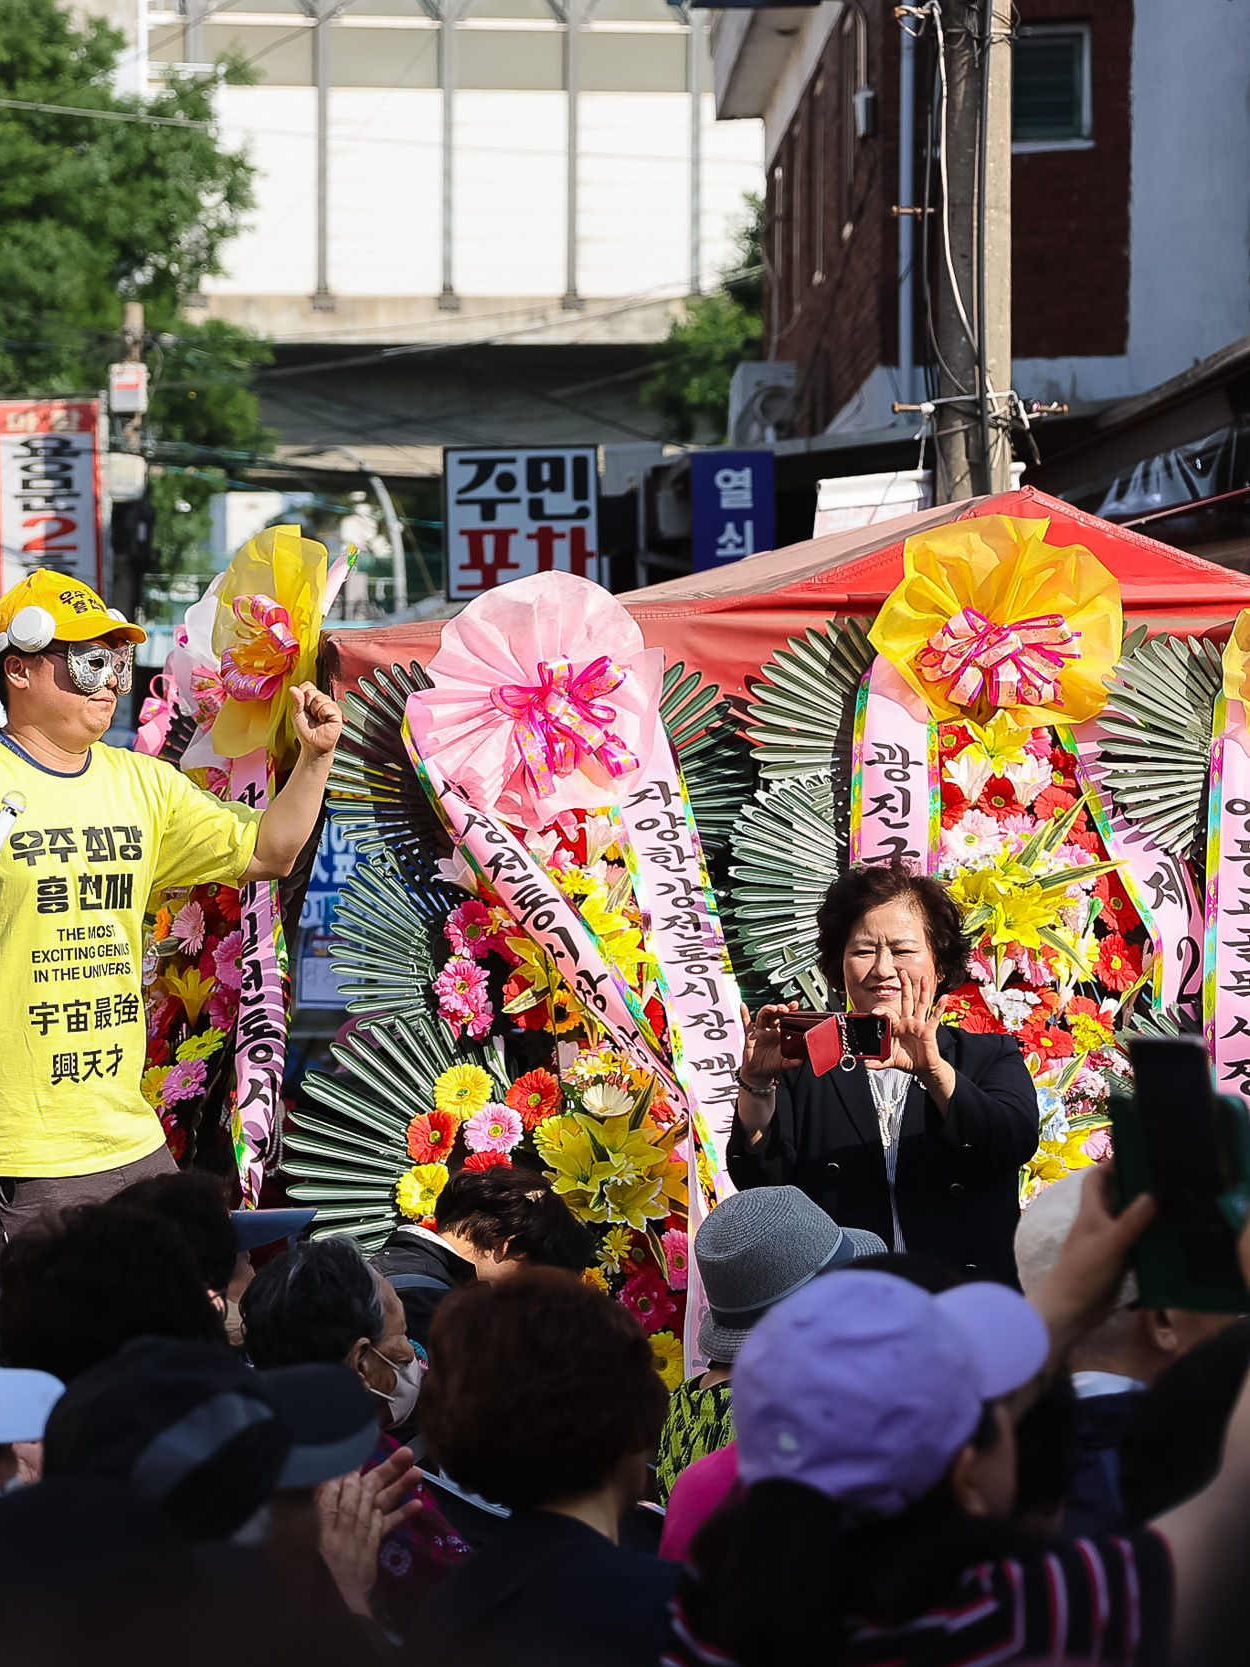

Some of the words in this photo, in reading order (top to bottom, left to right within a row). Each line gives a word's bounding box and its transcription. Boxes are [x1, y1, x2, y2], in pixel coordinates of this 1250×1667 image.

[455, 456, 591, 521] 주민
[714, 466, 754, 557] 열쇠
[459, 525, 597, 591] 포차
[862, 742, 924, 865] 광진구
[10, 827, 78, 867] 우주
[82, 825, 143, 862] 최강
[37, 876, 69, 914] 흥
[78, 873, 133, 911] 천재
[622, 781, 735, 1041] 자양한강전통시장
[31, 946, 96, 964] EXCITING
[56, 927, 85, 942] THE
[88, 924, 116, 940] MOST
[34, 968, 49, 983] IN
[52, 966, 80, 982] THE
[82, 962, 134, 980] UNIVERS
[29, 992, 140, 1037] 宇宙最強
[51, 1043, 124, 1086] 興天才
